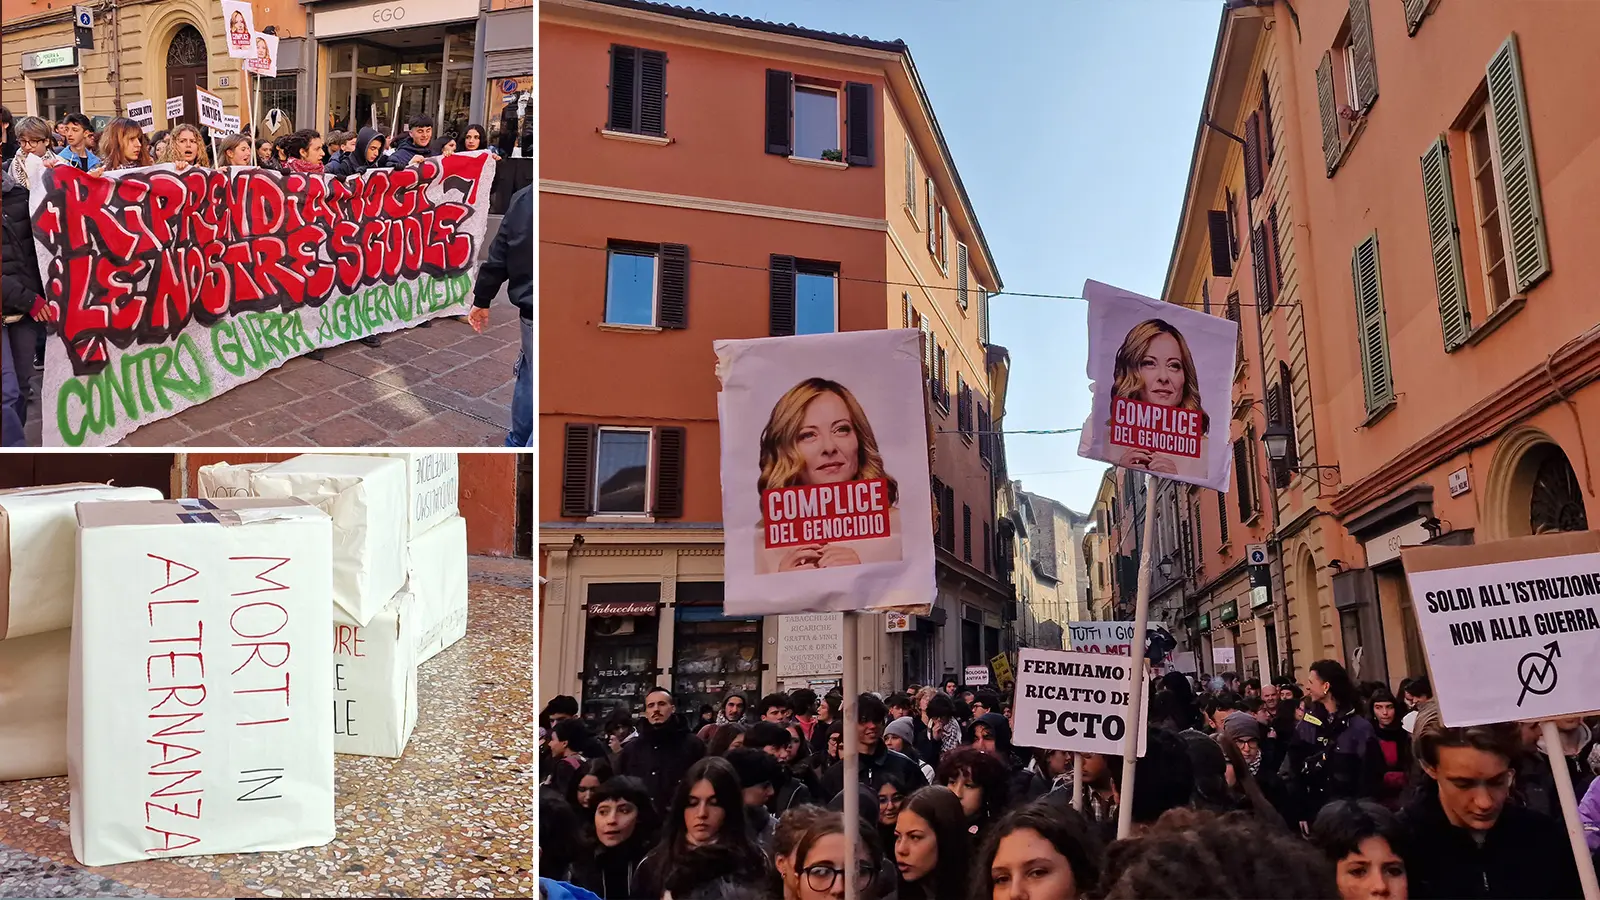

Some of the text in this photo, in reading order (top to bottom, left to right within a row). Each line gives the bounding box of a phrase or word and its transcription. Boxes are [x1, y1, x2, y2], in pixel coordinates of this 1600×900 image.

[372, 6, 405, 23] EGO
[202, 104, 222, 123] ANTIFA
[152, 222, 338, 332] NOSTRE
[330, 200, 475, 296] SCUOLE
[56, 333, 213, 446] CONTRO
[211, 309, 317, 378] GUERRA
[332, 281, 413, 341] GOVERNO
[1115, 399, 1198, 437] COMPLICE
[1114, 425, 1197, 455] DEL GENOCIDIO
[768, 481, 884, 521] COMPLICE
[770, 513, 885, 545] DEL GENOCIDIO
[1388, 535, 1401, 552] EGO
[590, 602, 656, 614] Tabaccheria
[1425, 587, 1476, 613] SOLDI
[791, 624, 832, 632] RICARICHE
[1069, 626, 1101, 641] TUTTI
[1449, 607, 1600, 646] NON ALLA GUERRA
[784, 644, 808, 652] SNACK
[228, 556, 291, 802] MORTI IN
[598, 669, 629, 677] RELX
[1023, 659, 1124, 680] FERMIAMO
[145, 553, 207, 853] ALTERNANZA
[1025, 684, 1107, 704] RICATTO
[1036, 709, 1126, 741] PCTO
